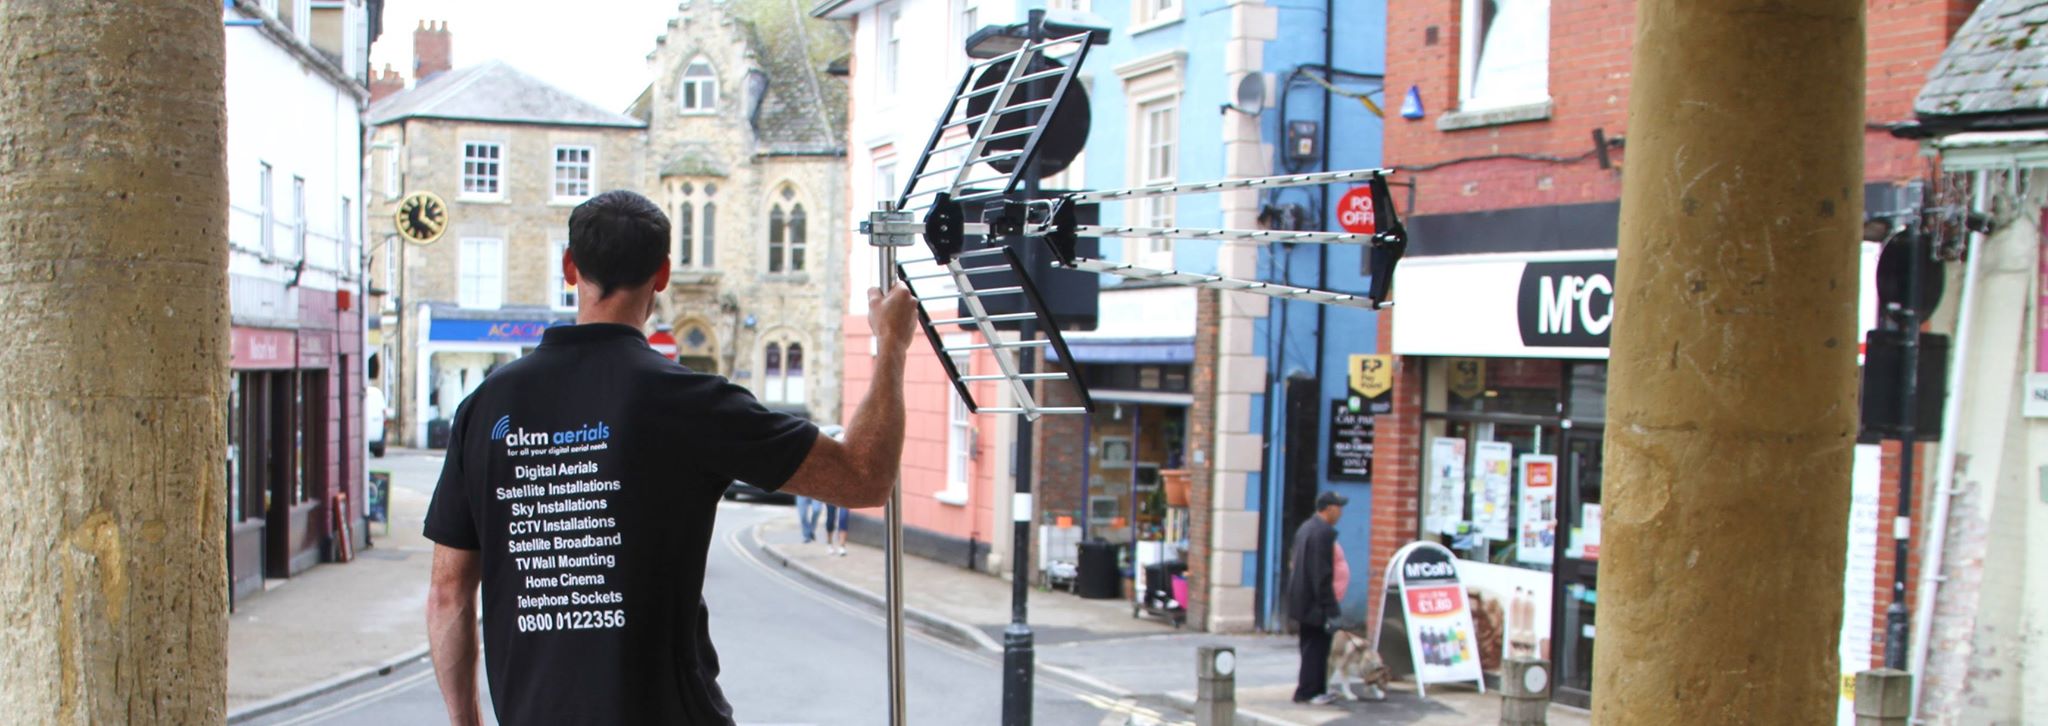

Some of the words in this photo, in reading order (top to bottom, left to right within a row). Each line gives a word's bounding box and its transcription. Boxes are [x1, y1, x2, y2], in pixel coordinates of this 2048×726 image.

[506, 427, 549, 447] akm
[553, 421, 609, 445] aerials
[507, 448, 518, 456] for
[520, 448, 529, 456] all
[531, 448, 547, 457] your
[548, 446, 570, 456] digital
[571, 444, 589, 453] aerial
[590, 442, 608, 451] needs
[515, 463, 556, 481] Digital
[558, 460, 599, 476] Aerials
[496, 484, 546, 500] Satellite
[549, 479, 621, 495] Installations
[511, 503, 535, 518] Sky
[537, 498, 608, 514] Installations
[509, 520, 542, 535] CCTV
[543, 516, 616, 532] Installations
[508, 538, 551, 553] Satellite
[554, 532, 622, 549] Broadband
[515, 557, 531, 571] TV
[532, 556, 556, 569] Wall
[558, 553, 616, 568] Mounting
[526, 575, 558, 588] Home
[560, 573, 605, 586] Cinema
[518, 593, 569, 609] Telephone
[571, 591, 623, 605] Sockets
[517, 613, 553, 633] 0800
[556, 609, 626, 630] 0122356
